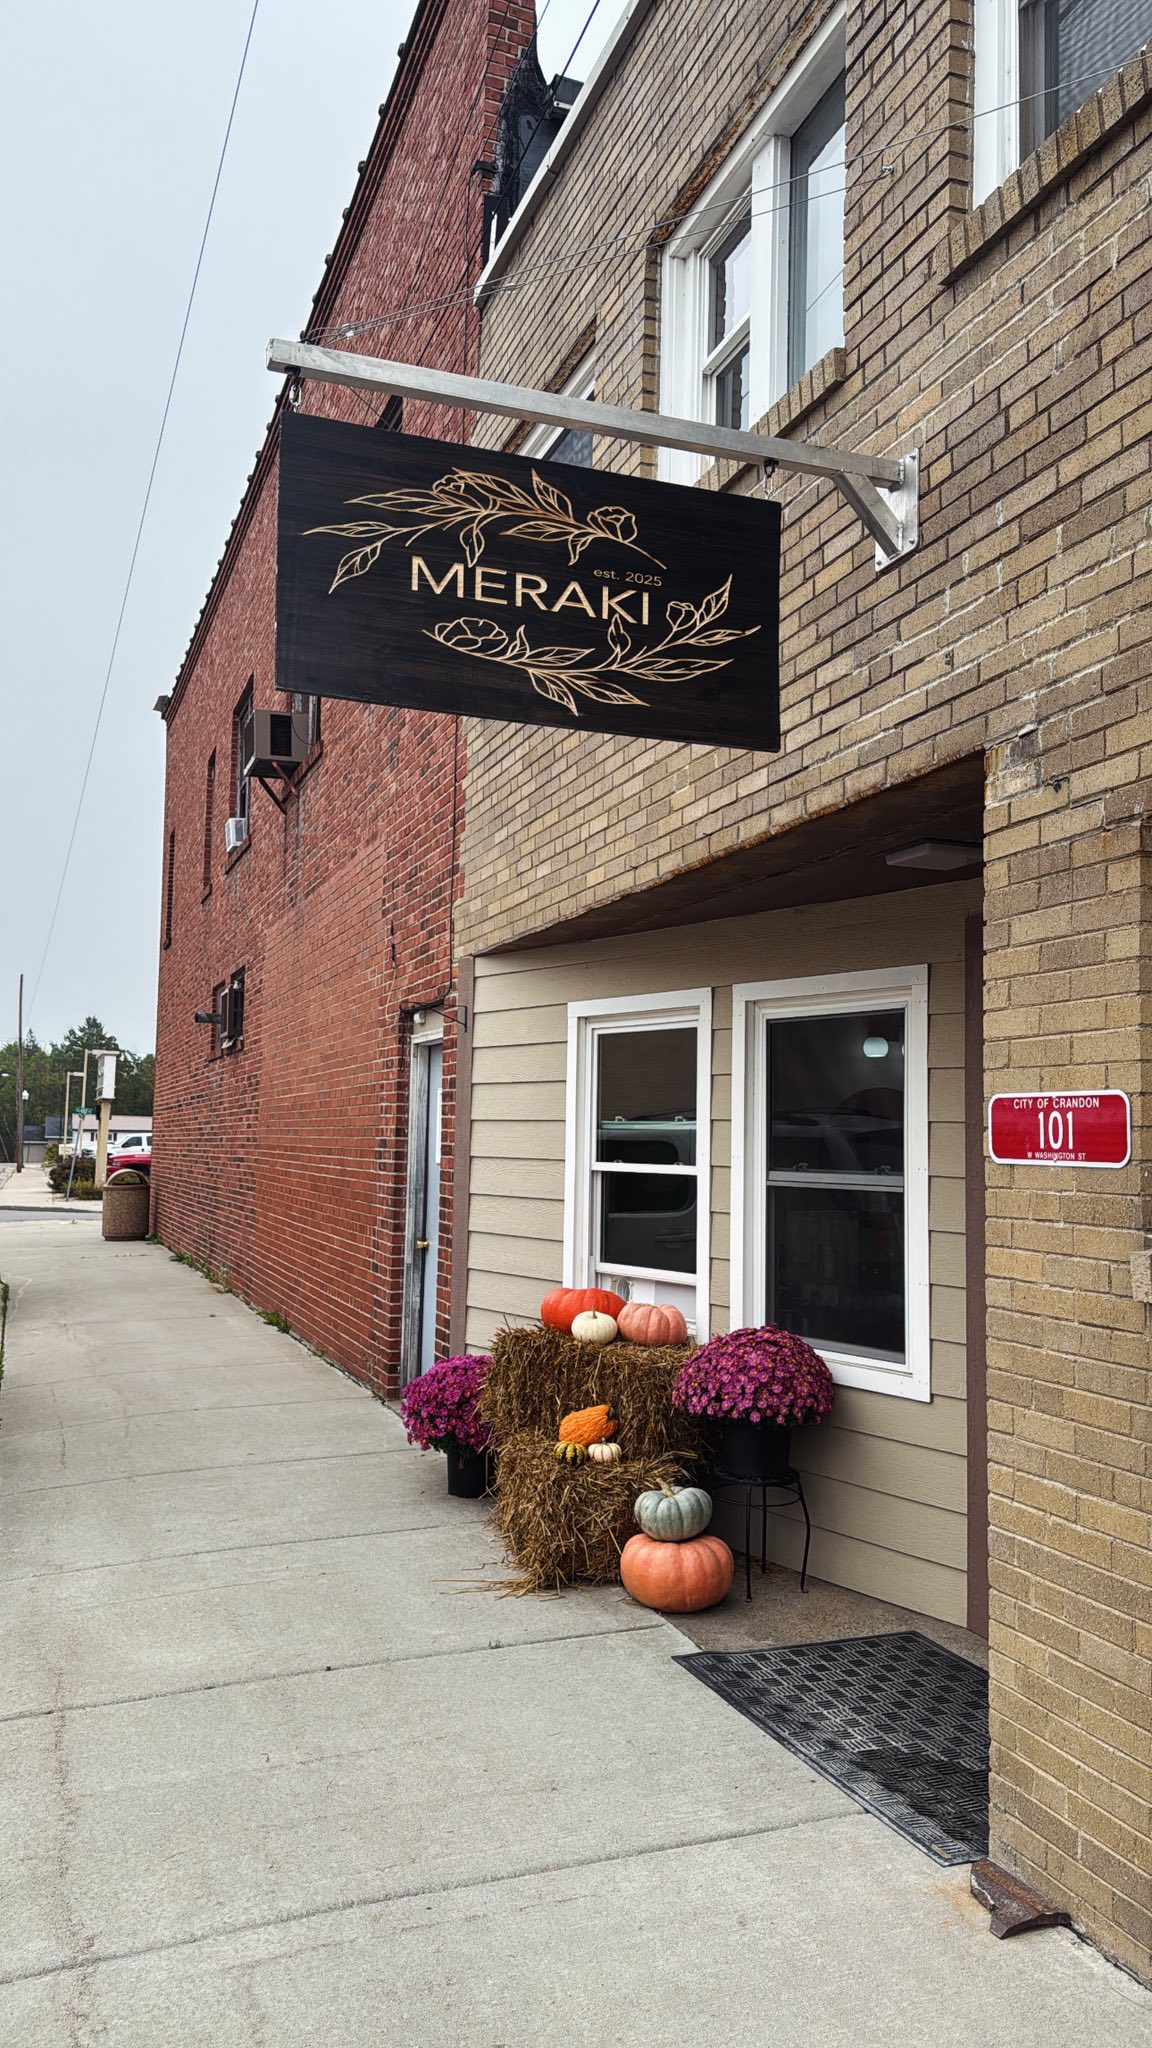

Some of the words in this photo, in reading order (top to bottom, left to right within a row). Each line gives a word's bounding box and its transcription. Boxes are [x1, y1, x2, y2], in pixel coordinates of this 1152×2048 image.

[593, 569, 620, 580] est.
[625, 571, 662, 587] 2025
[411, 555, 649, 625] MERAKI
[1013, 1098, 1033, 1109] CITY
[1037, 1098, 1049, 1109] OF
[1053, 1097, 1099, 1108] CRANDON
[1038, 1110, 1073, 1150] 101
[1027, 1151, 1033, 1159] W
[1077, 1152, 1086, 1160] ST
